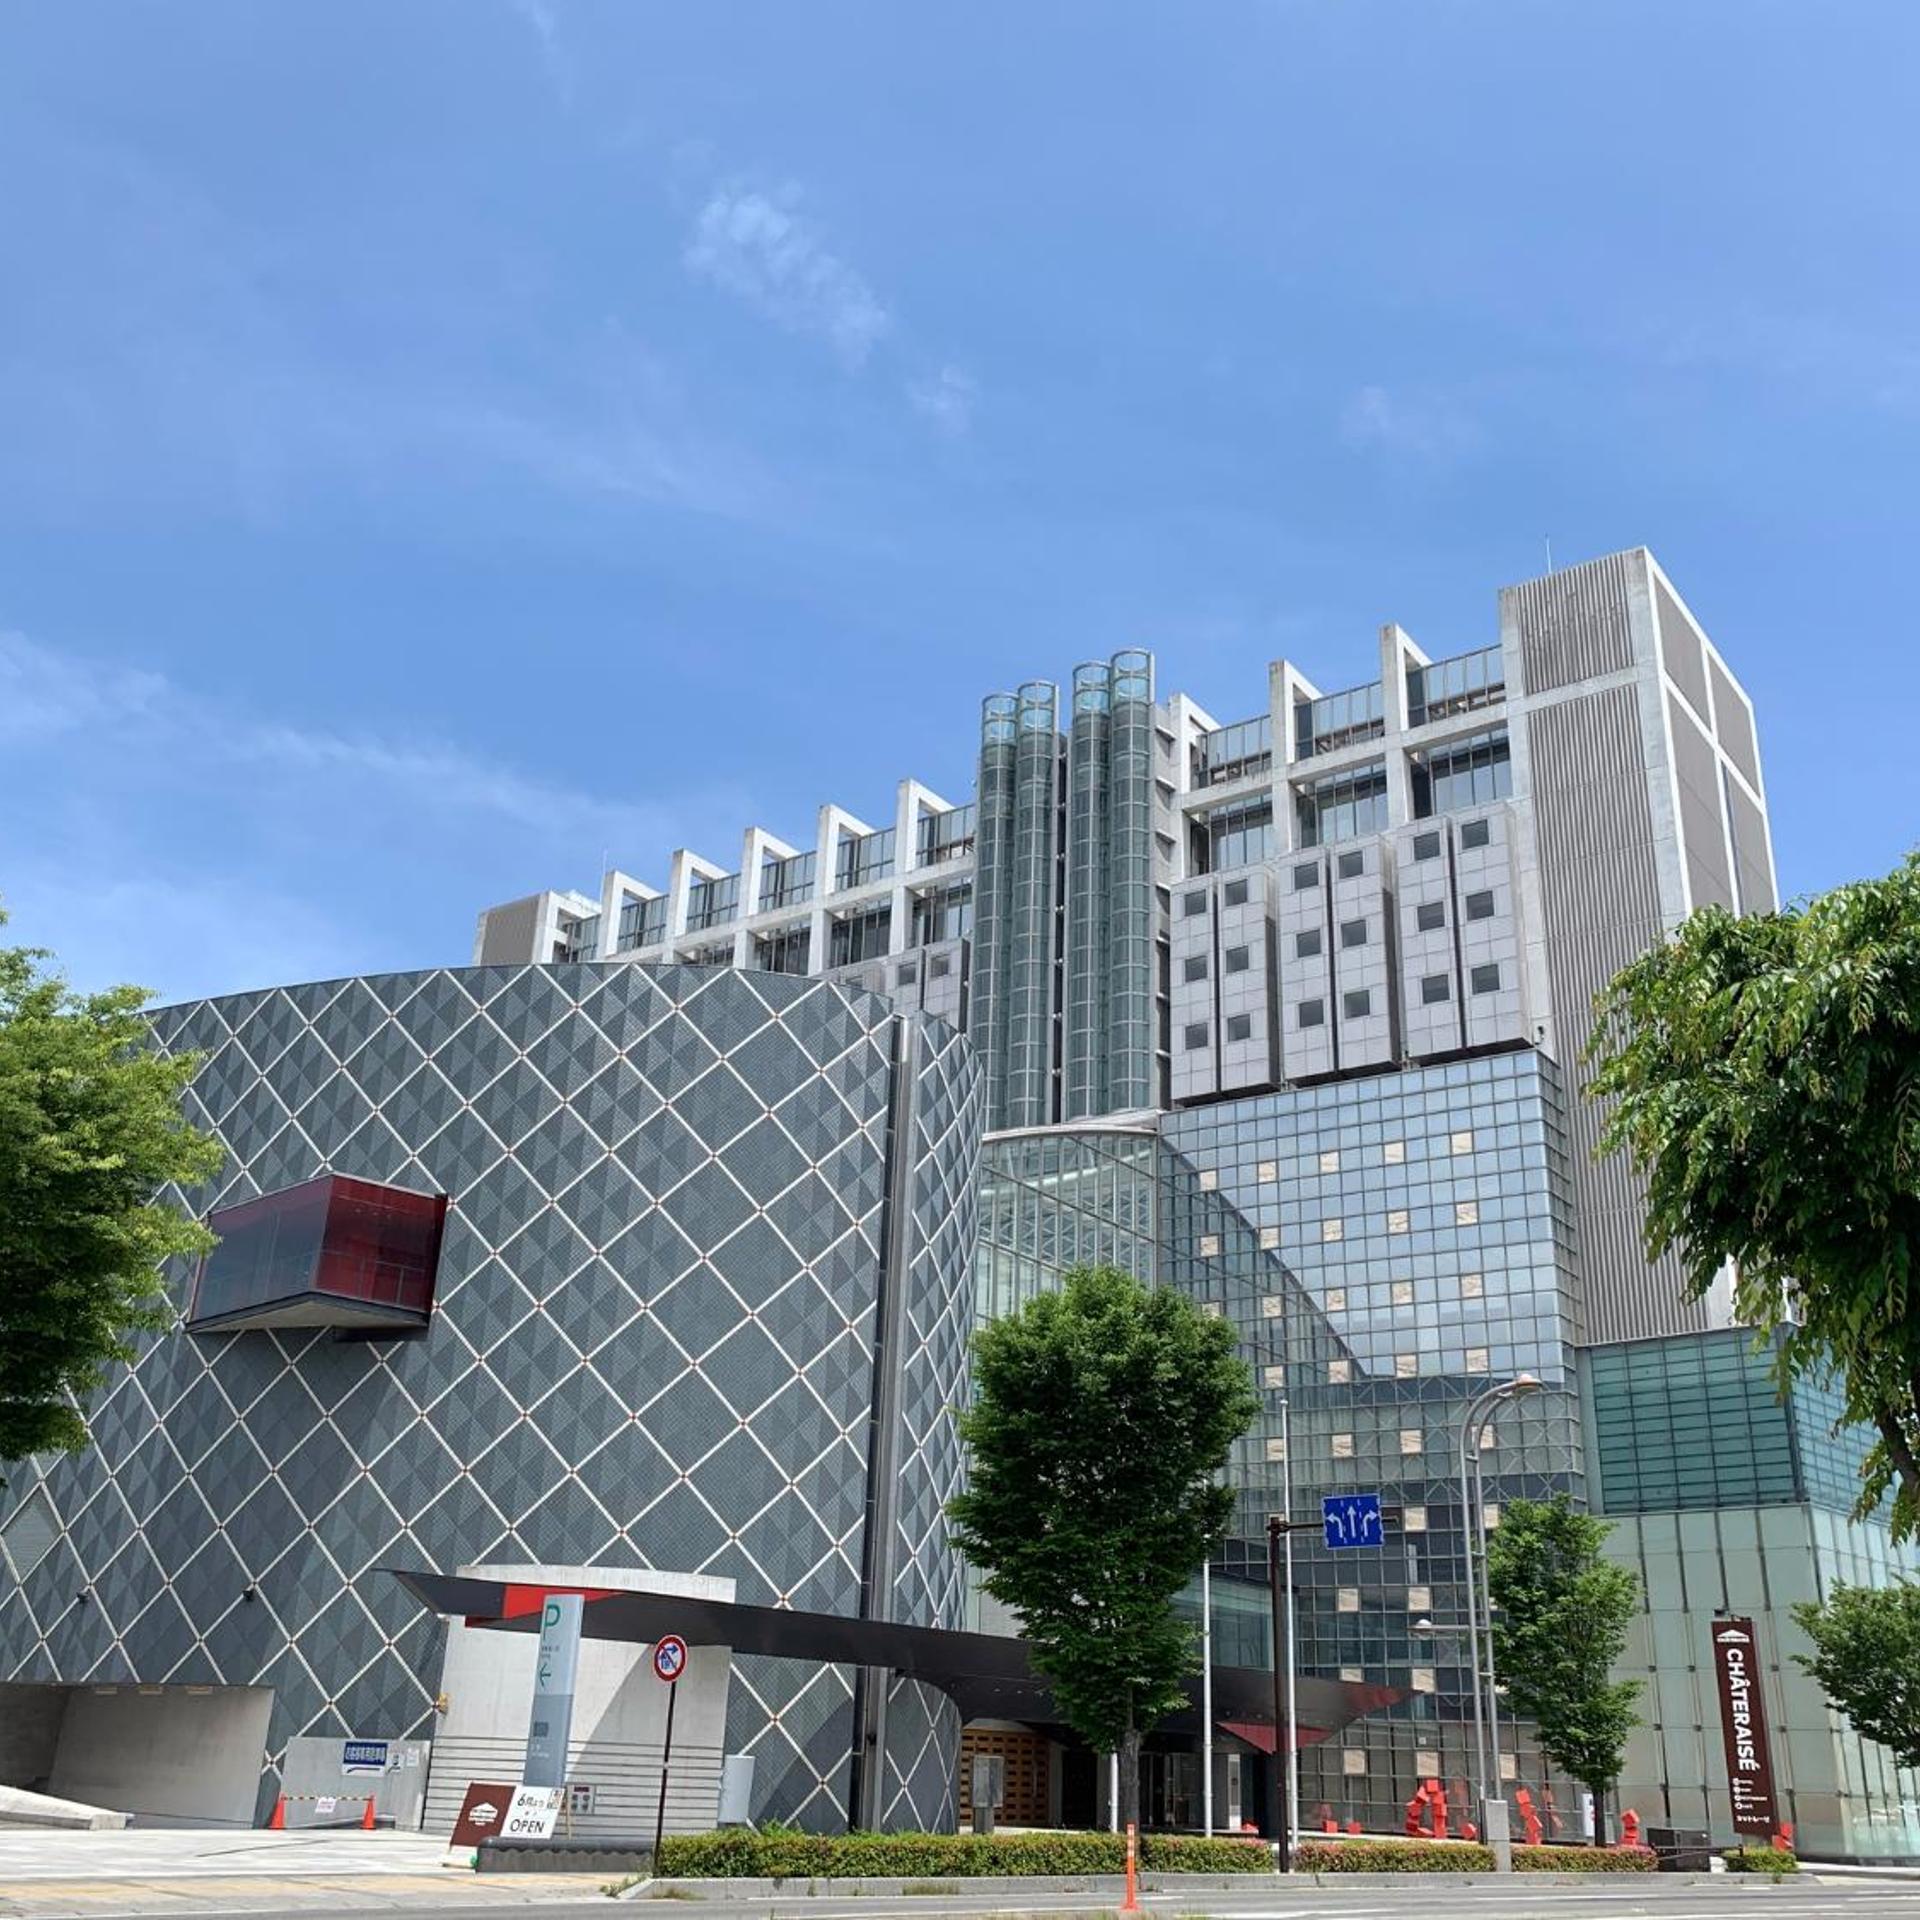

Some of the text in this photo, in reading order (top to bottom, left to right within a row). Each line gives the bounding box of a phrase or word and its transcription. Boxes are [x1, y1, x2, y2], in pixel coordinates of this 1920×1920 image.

[543, 1604, 561, 1641] P
[1726, 1648, 1761, 1771] CHÂTERAISÉ
[510, 1818, 545, 1833] OPEN
